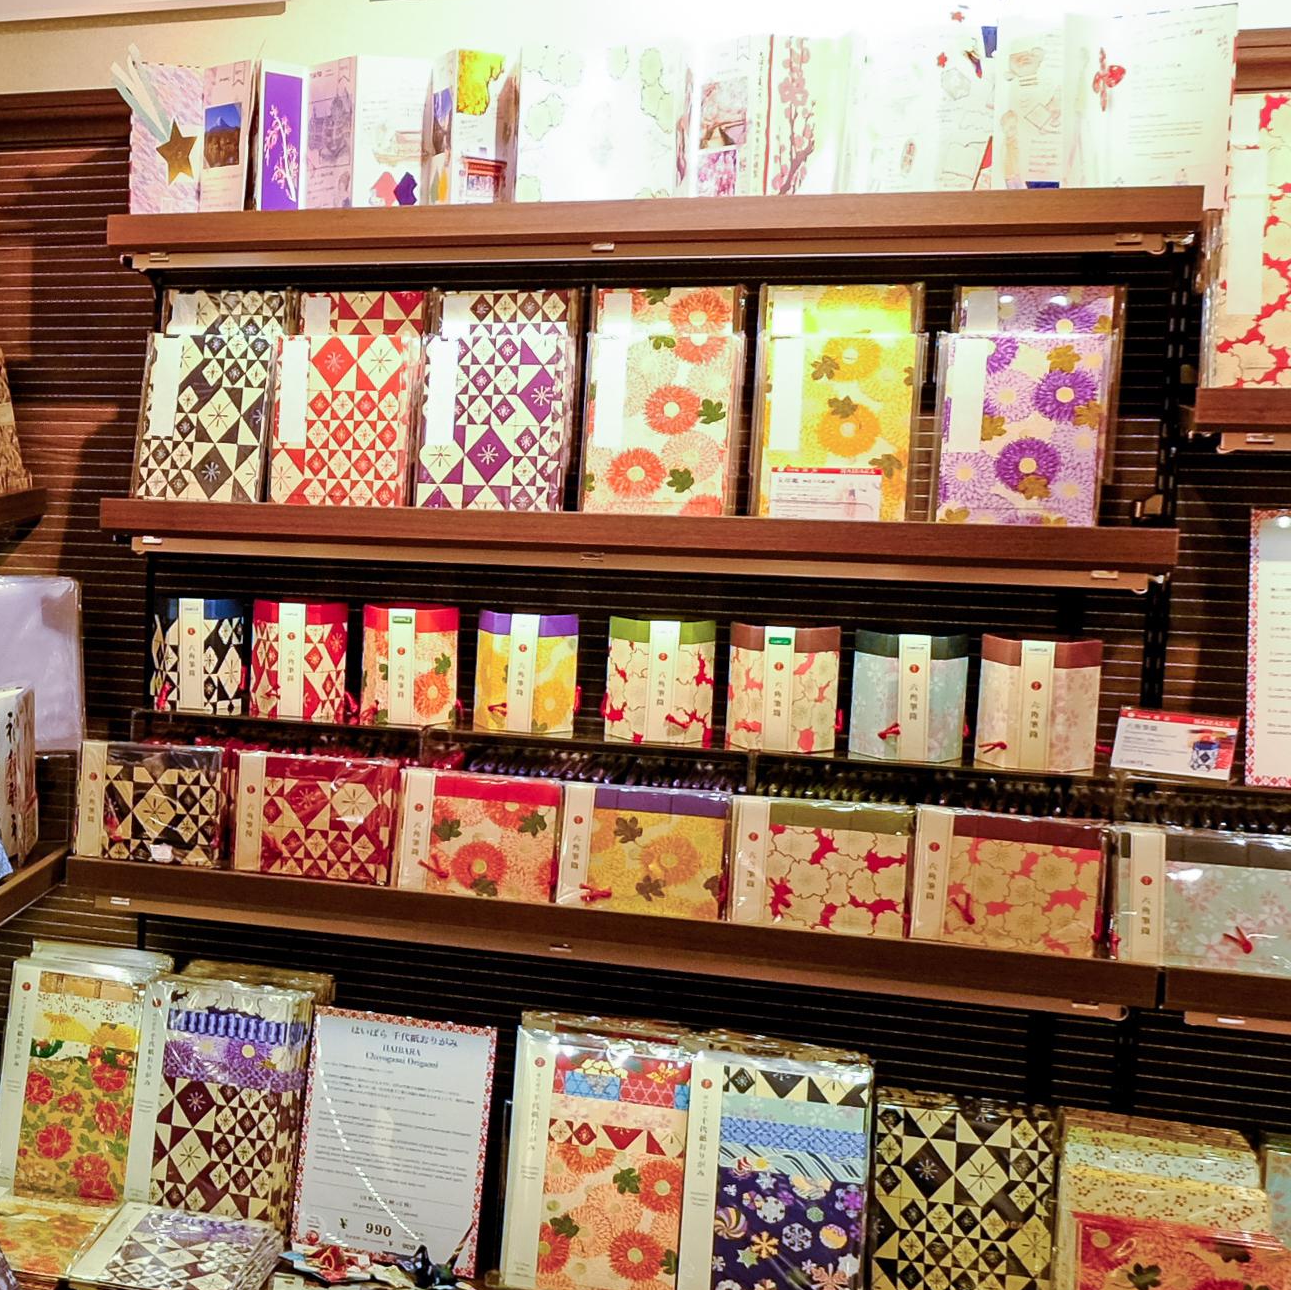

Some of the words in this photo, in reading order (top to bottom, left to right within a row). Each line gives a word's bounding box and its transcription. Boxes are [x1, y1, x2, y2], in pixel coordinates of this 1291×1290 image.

[383, 1044, 421, 1057] HAIBARA
[407, 1057, 439, 1070] Origami
[365, 1222, 392, 1238] 990
